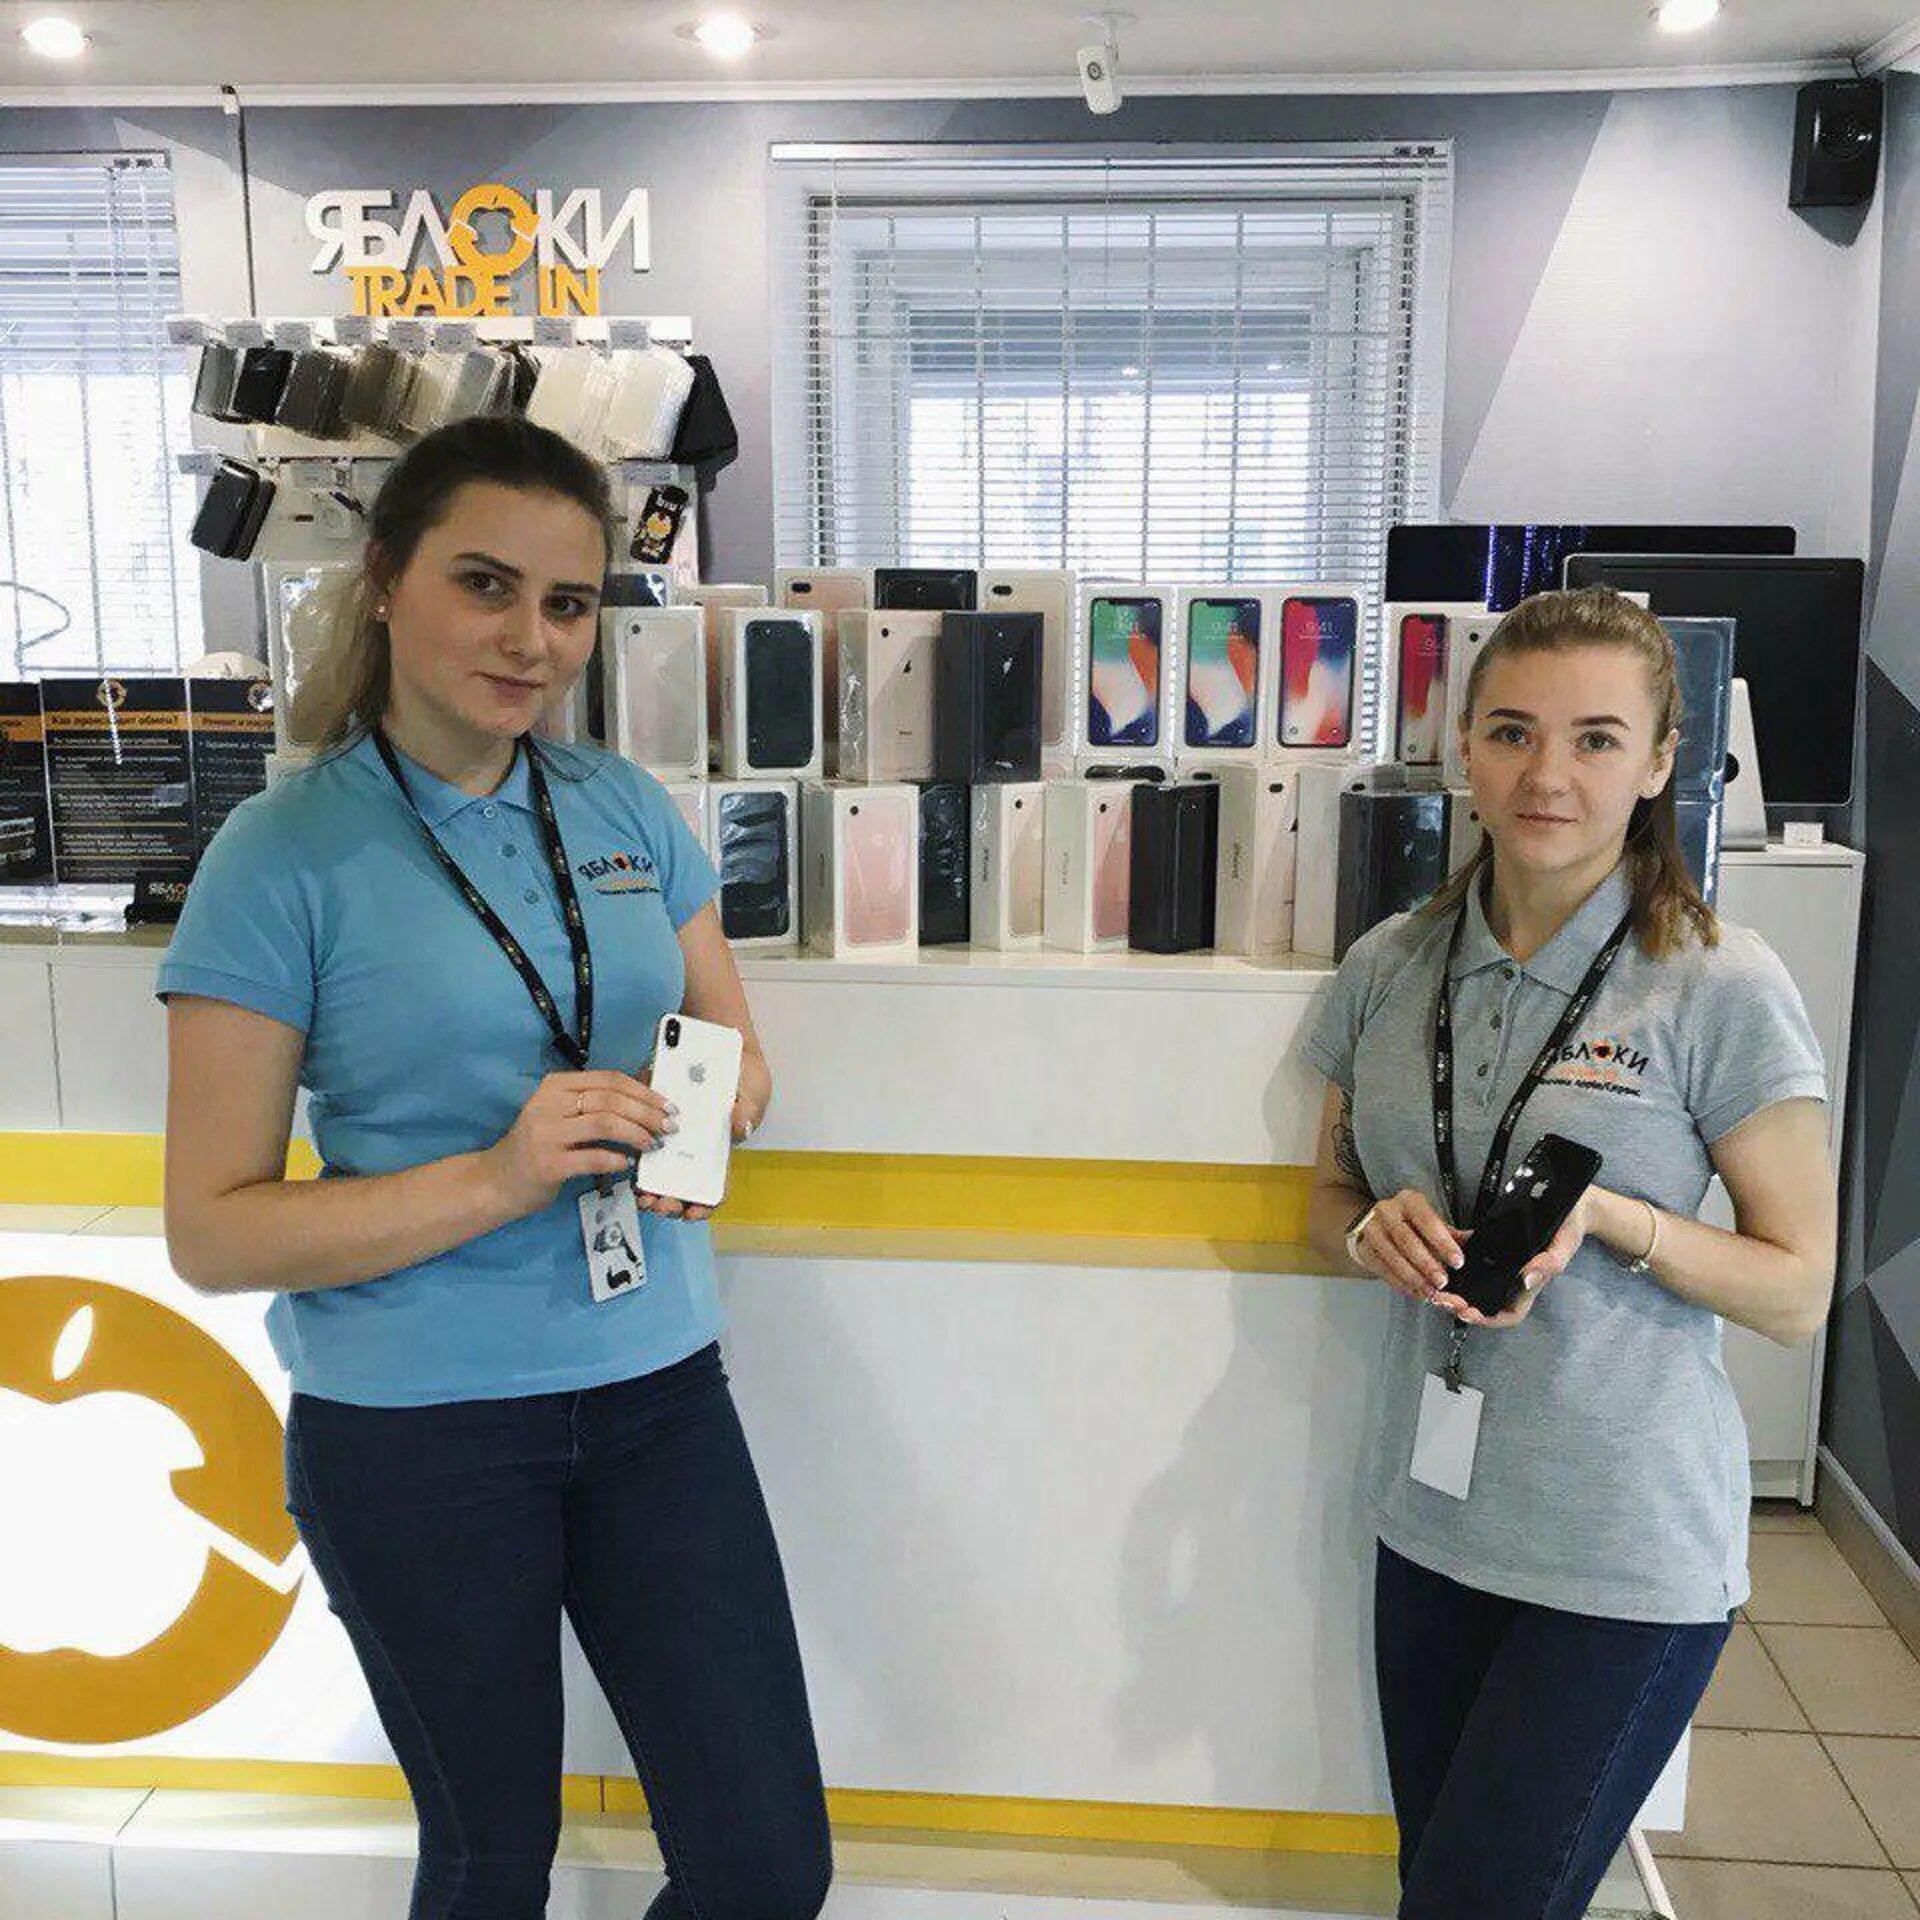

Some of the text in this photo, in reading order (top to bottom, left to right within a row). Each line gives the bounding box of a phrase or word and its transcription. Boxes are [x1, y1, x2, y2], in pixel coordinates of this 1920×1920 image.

[304, 184, 650, 273] ЯБЛОКИ
[346, 264, 600, 316] TRADE IN
